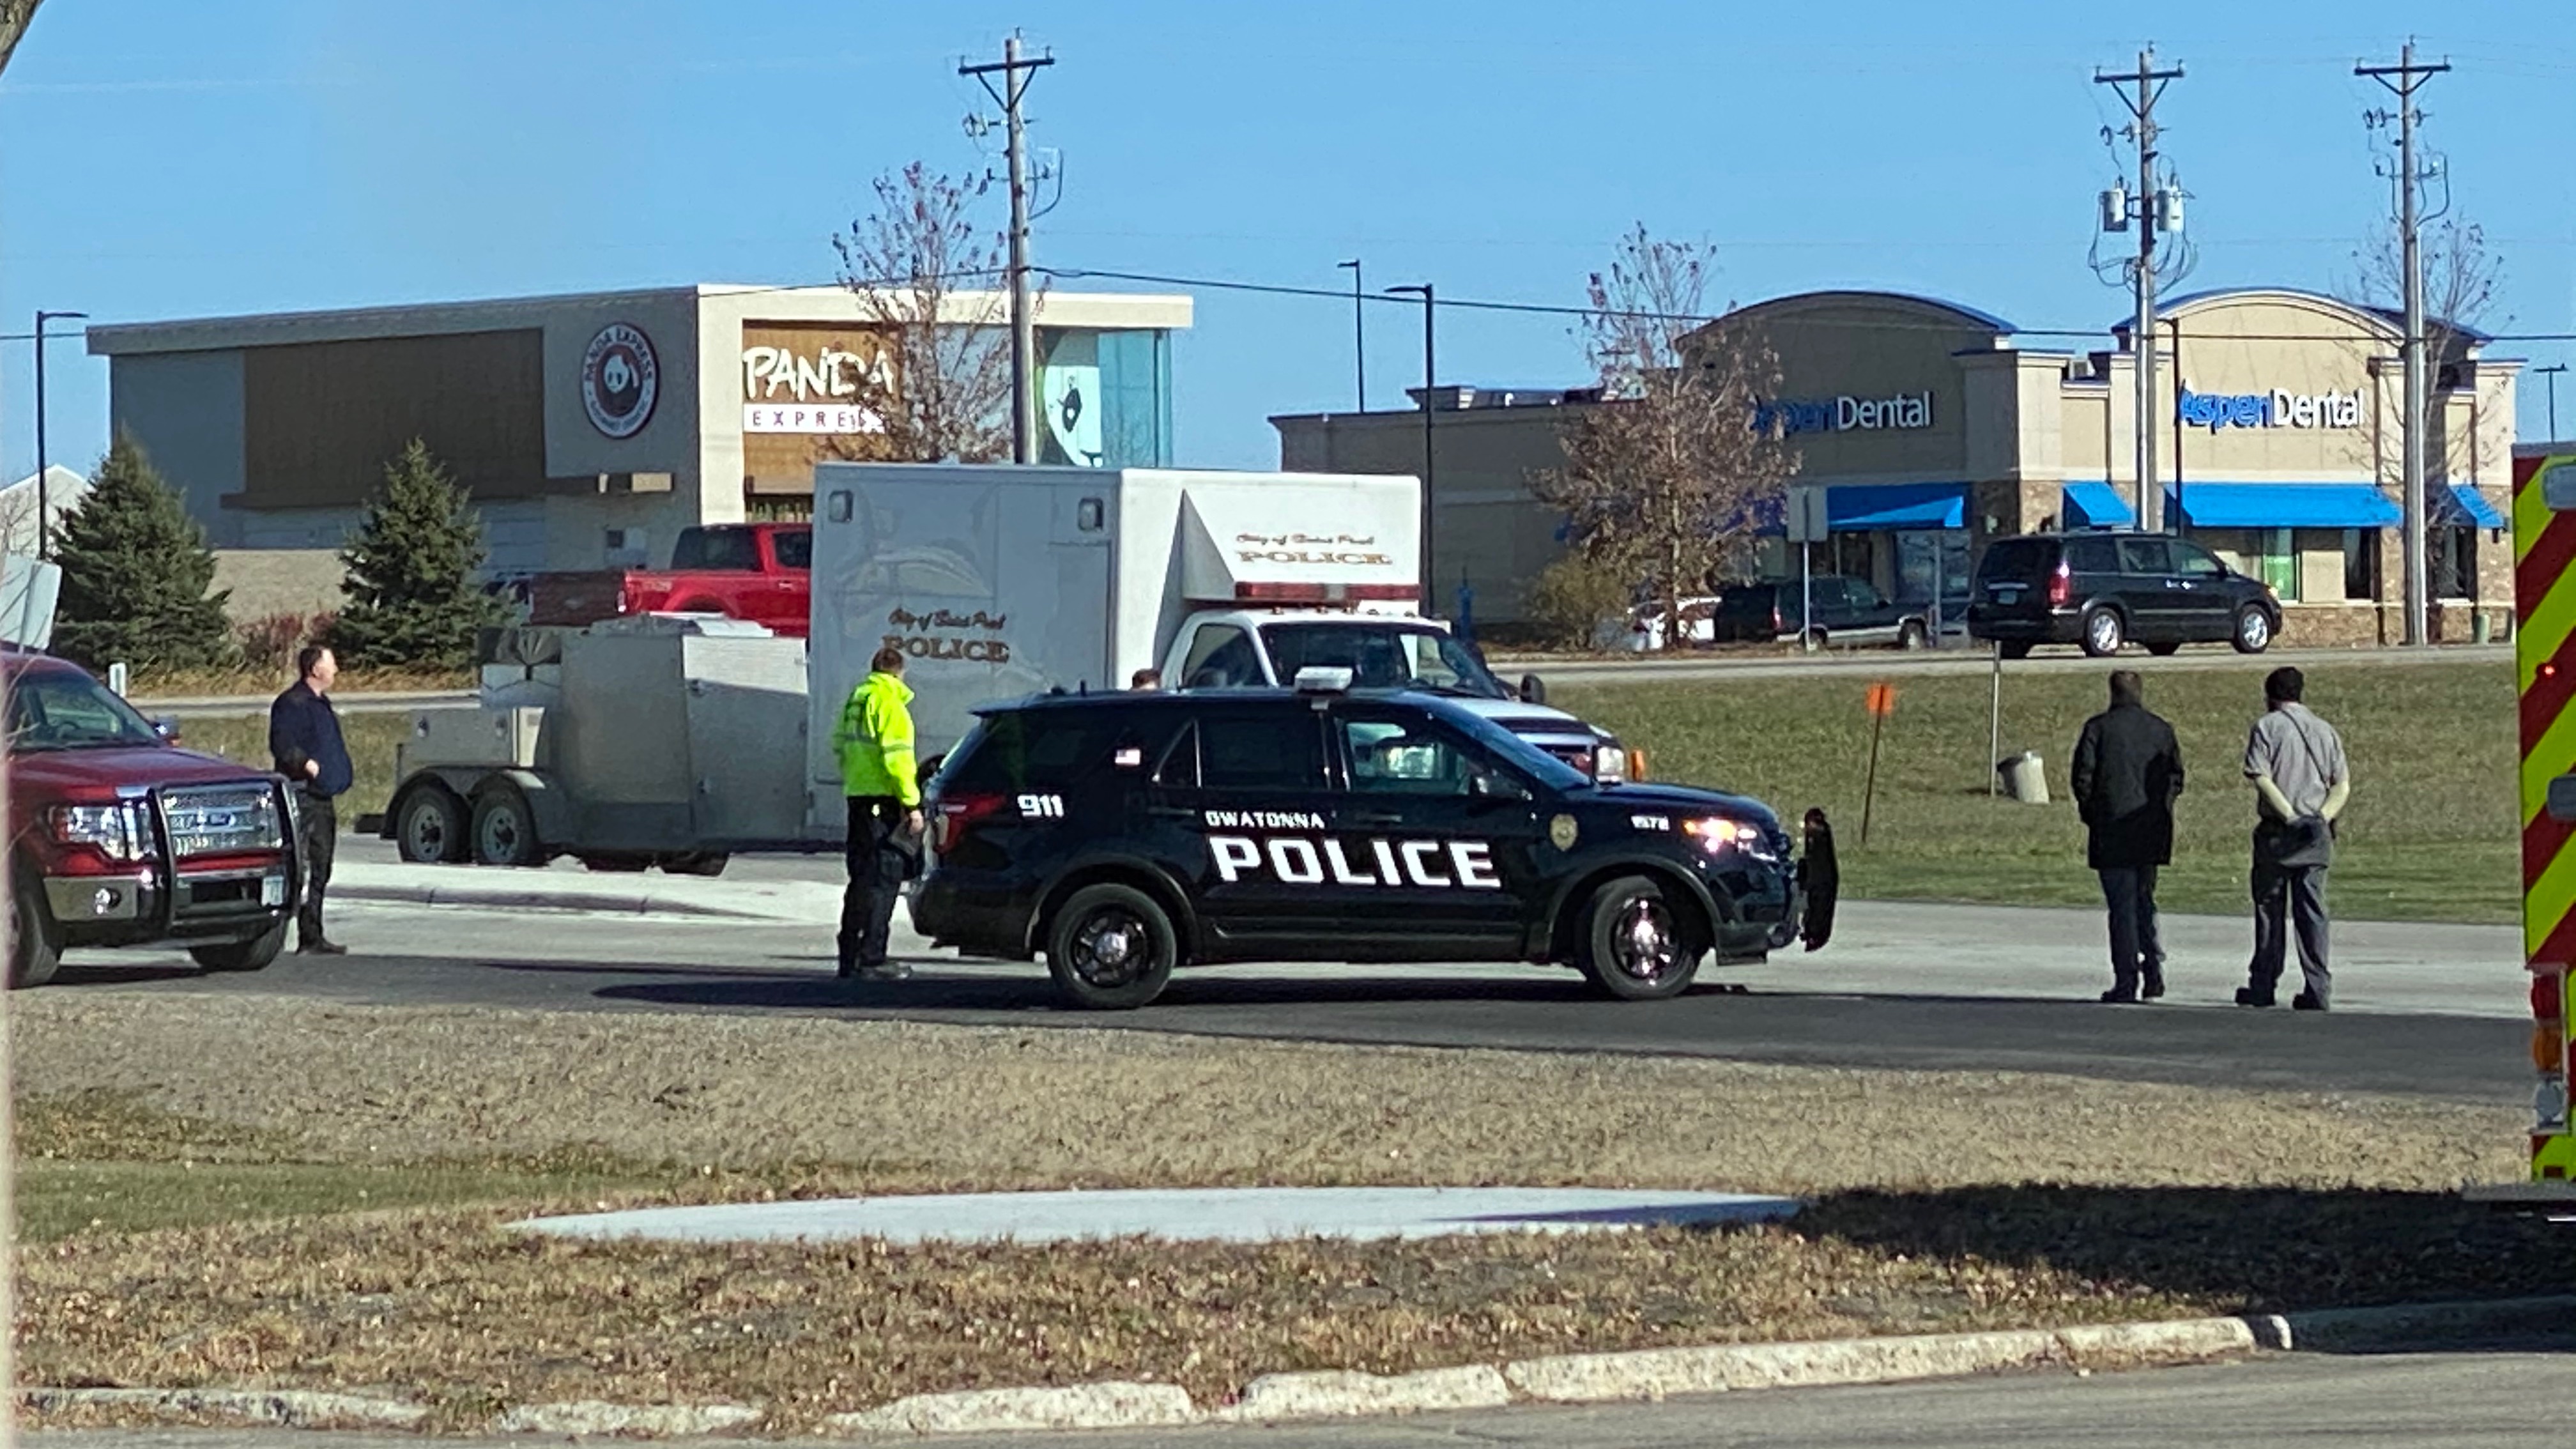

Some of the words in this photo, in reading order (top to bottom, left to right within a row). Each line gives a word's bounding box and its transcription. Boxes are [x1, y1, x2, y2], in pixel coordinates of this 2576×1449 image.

[742, 346, 894, 401] PANDA
[1236, 551, 1393, 565] POLICE
[882, 636, 1009, 663] POLICE
[1017, 795, 1064, 818] 911
[1206, 811, 1324, 829] OWATONNA
[1208, 836, 1501, 888] POLICE
